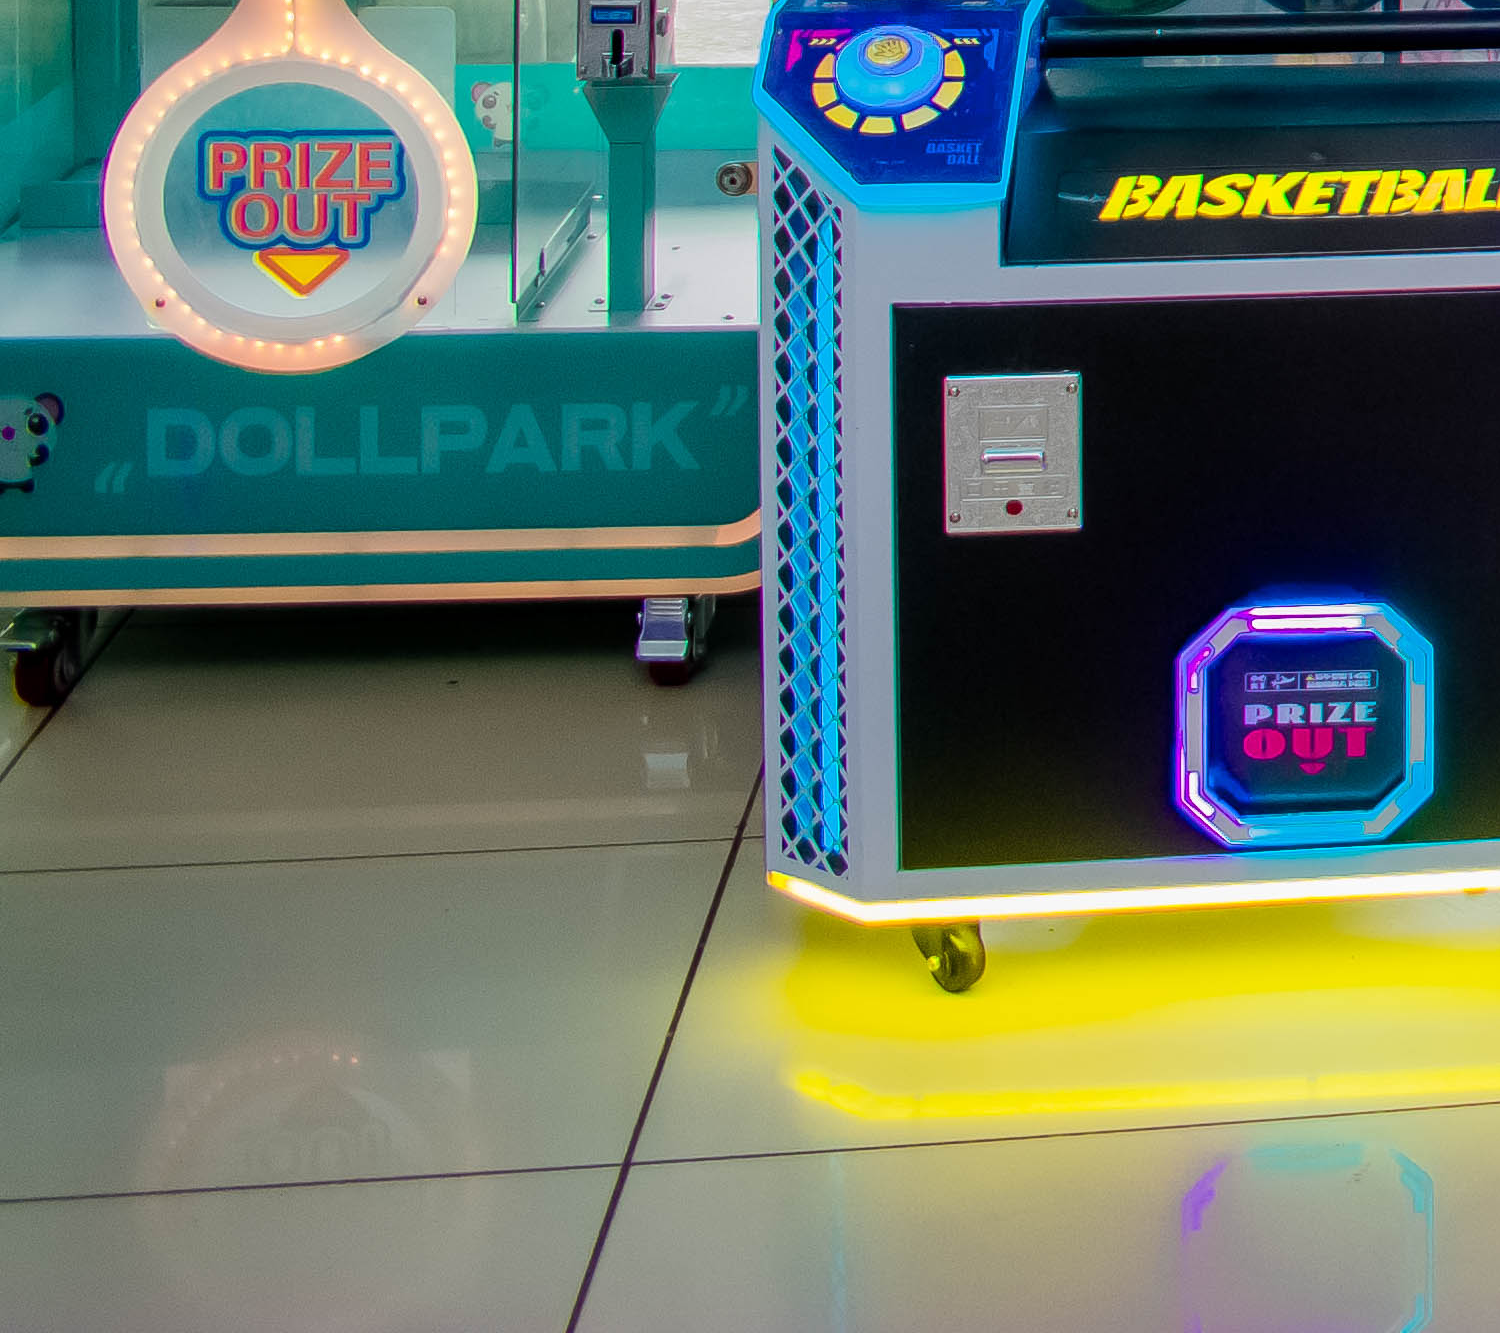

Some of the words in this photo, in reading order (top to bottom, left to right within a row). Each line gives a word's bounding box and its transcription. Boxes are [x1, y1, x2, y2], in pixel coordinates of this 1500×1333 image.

[206, 140, 394, 192] PRIZE
[227, 191, 375, 242] OUT
[1243, 701, 1378, 725] PRIZE
[1243, 726, 1375, 761] OUT
